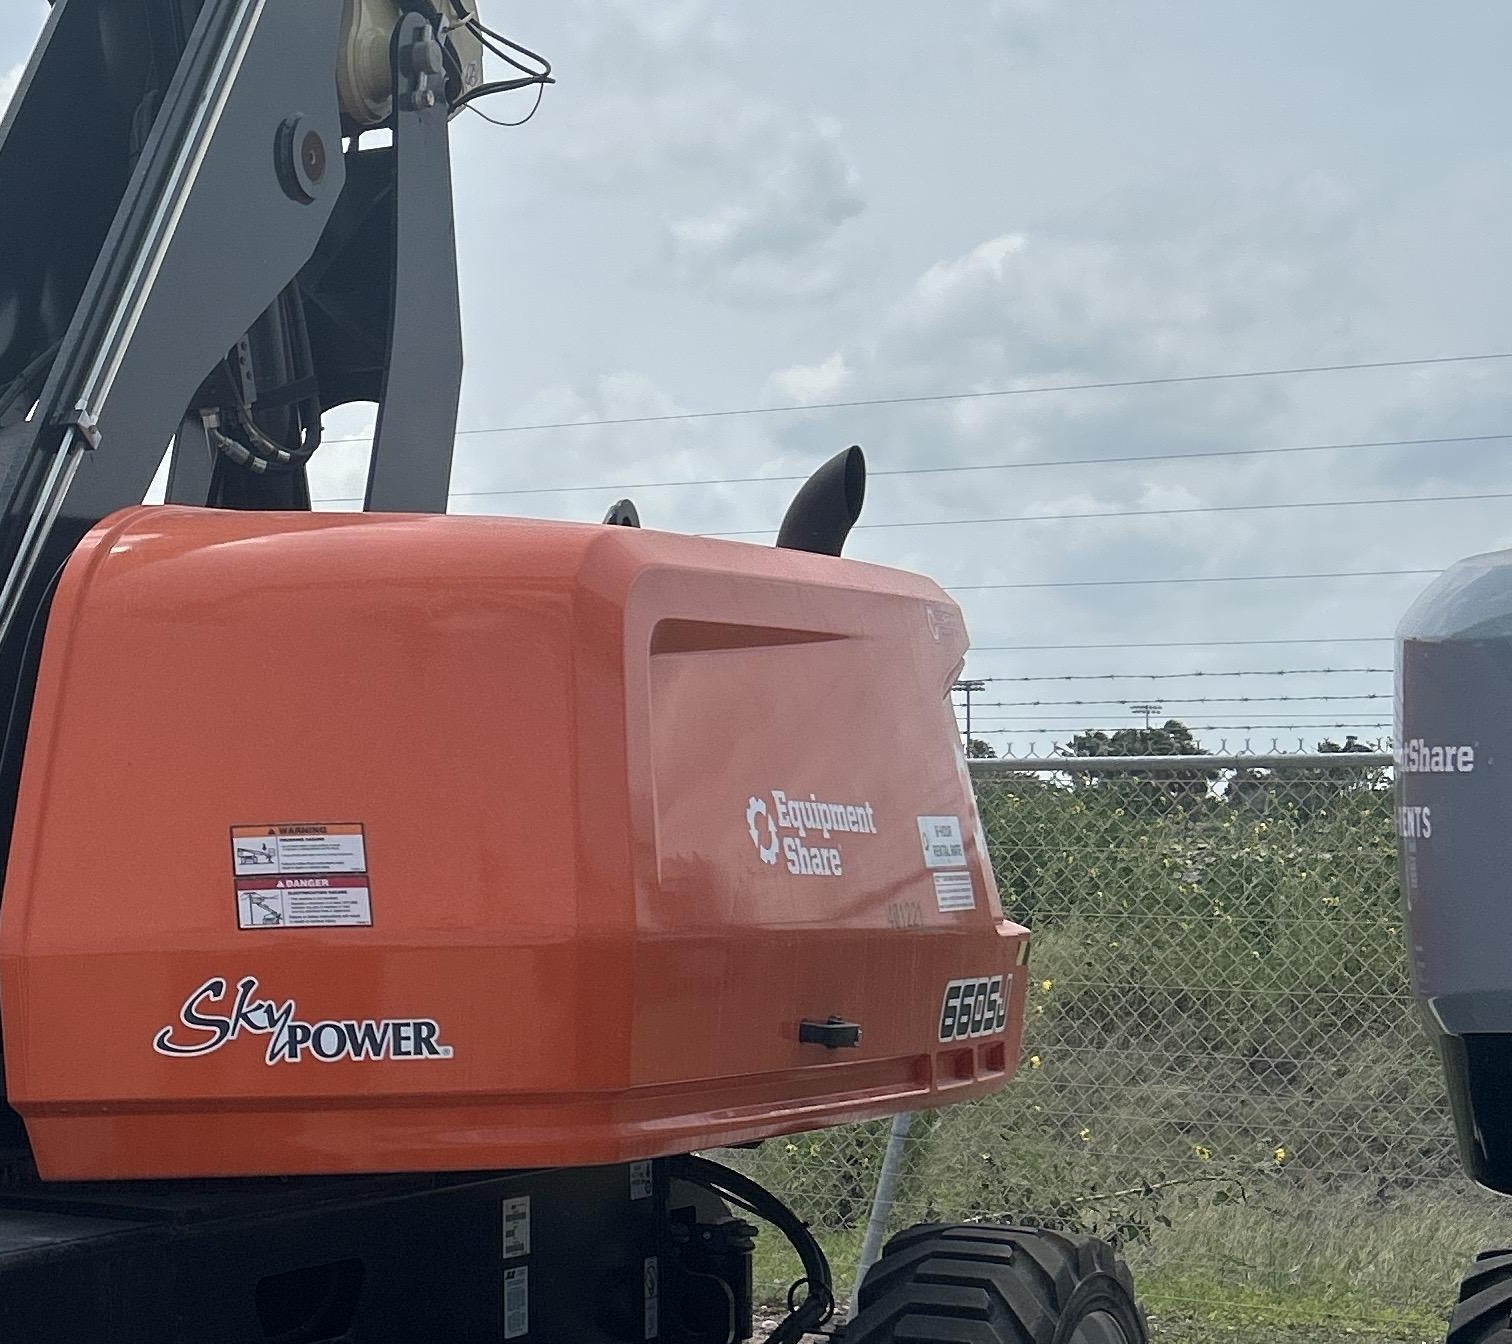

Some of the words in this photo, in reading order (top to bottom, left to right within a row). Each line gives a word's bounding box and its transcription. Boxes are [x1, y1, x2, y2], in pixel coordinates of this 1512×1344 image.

[771, 790, 878, 839] Equipment
[279, 826, 327, 834] WARNING
[783, 836, 843, 876] Share
[285, 878, 329, 888] DANGER
